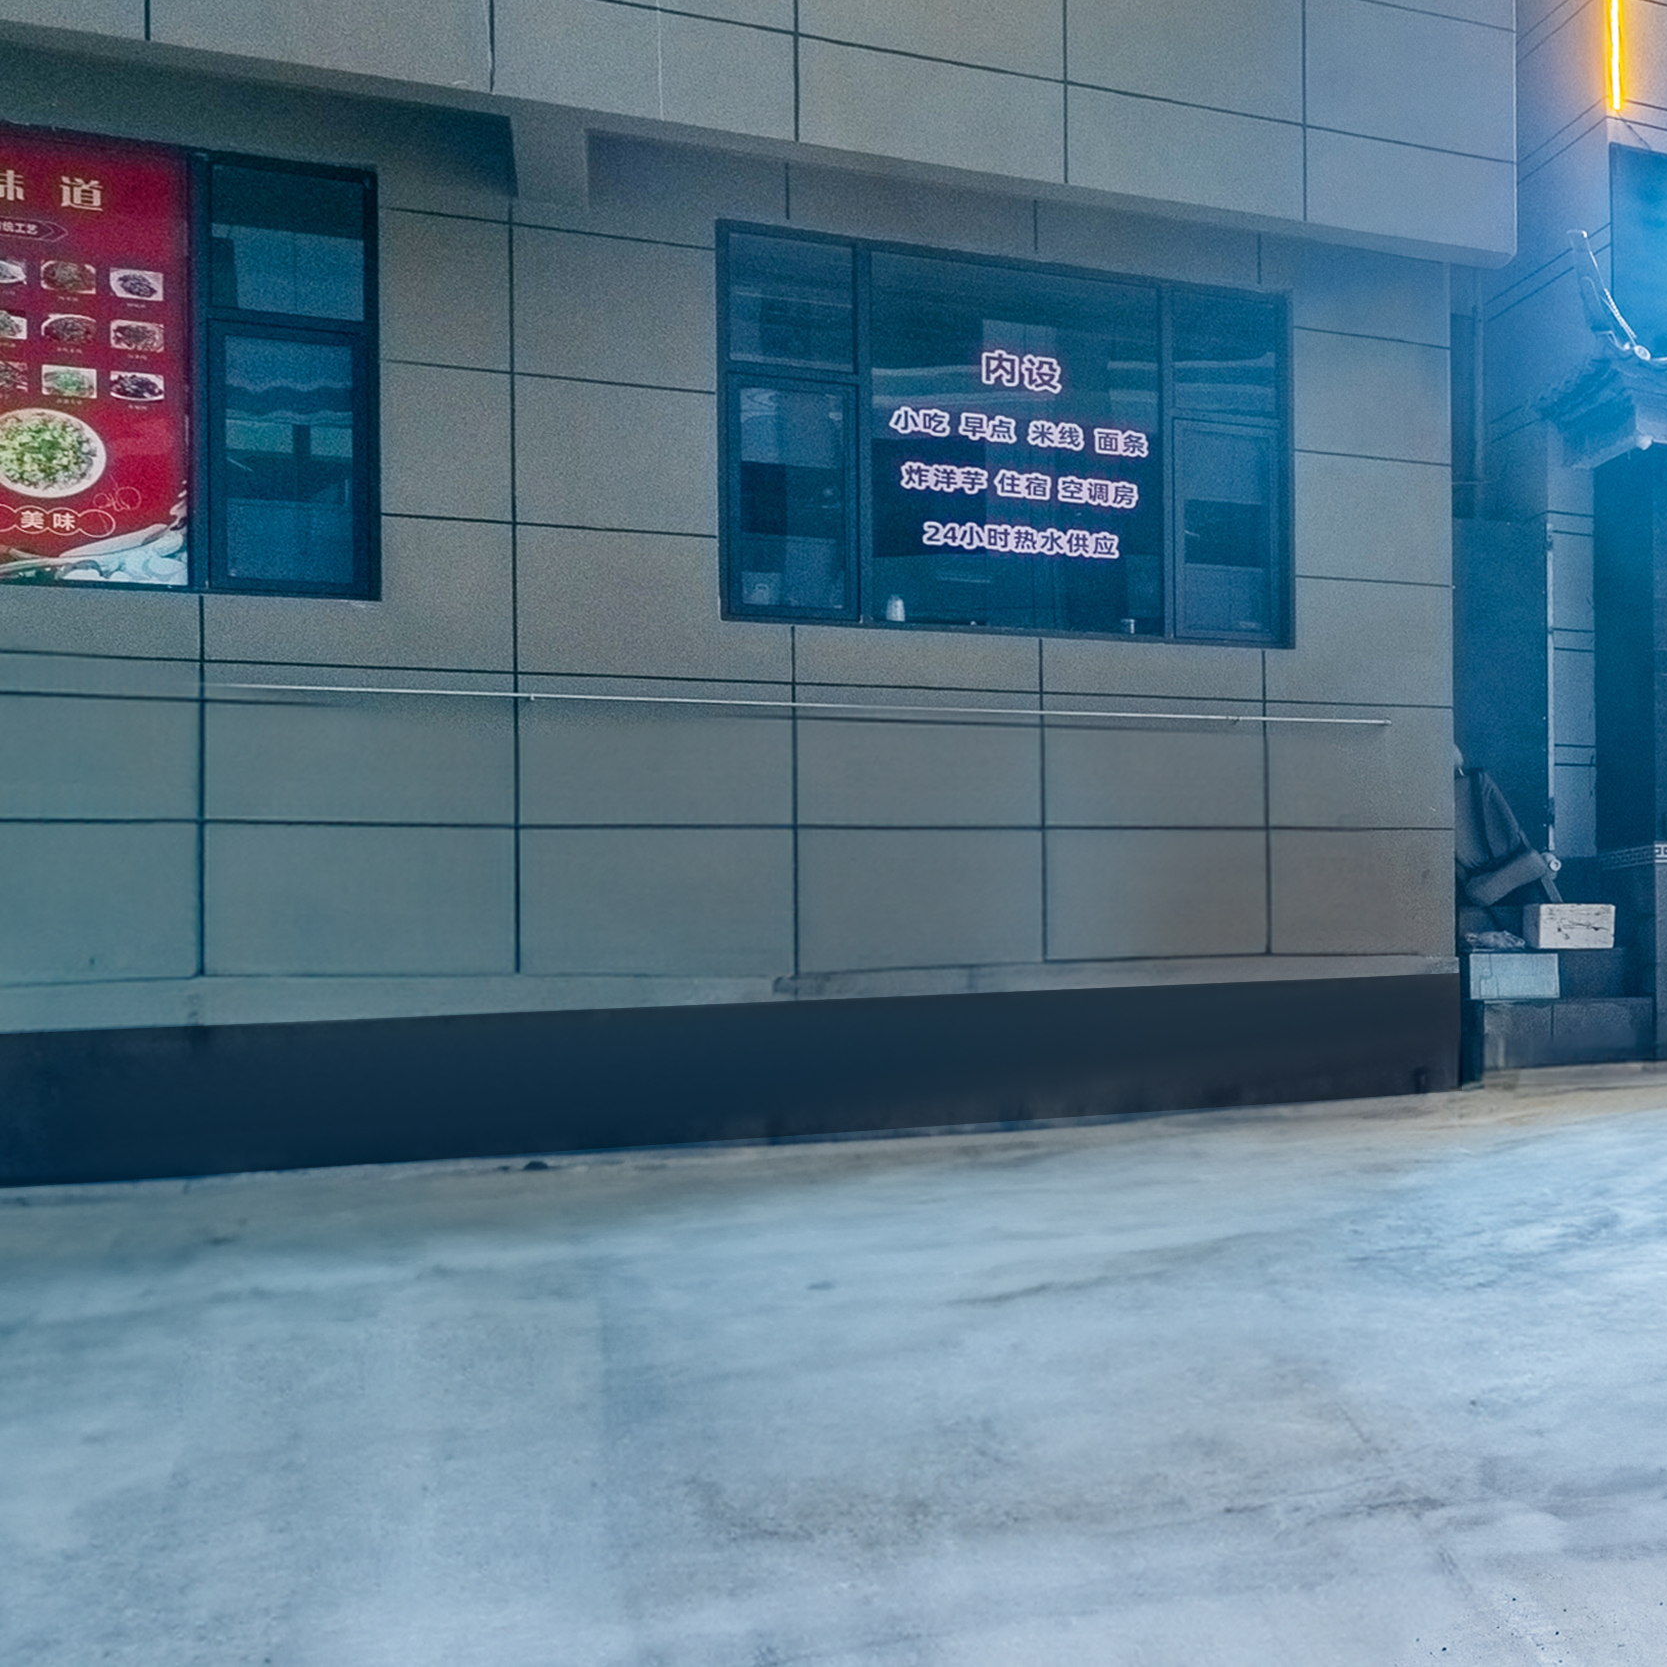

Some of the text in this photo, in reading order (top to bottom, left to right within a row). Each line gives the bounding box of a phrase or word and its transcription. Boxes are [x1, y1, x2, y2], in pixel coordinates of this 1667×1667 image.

[0, 220, 39, 235] 统工艺
[981, 349, 1063, 394] 内设
[889, 406, 1149, 458] 小吃 早点 米线 面条
[900, 461, 1140, 510] 炸洋芋 住宿 空调房
[20, 510, 76, 532] 美味
[922, 520, 1121, 560] 24小时热水供应
